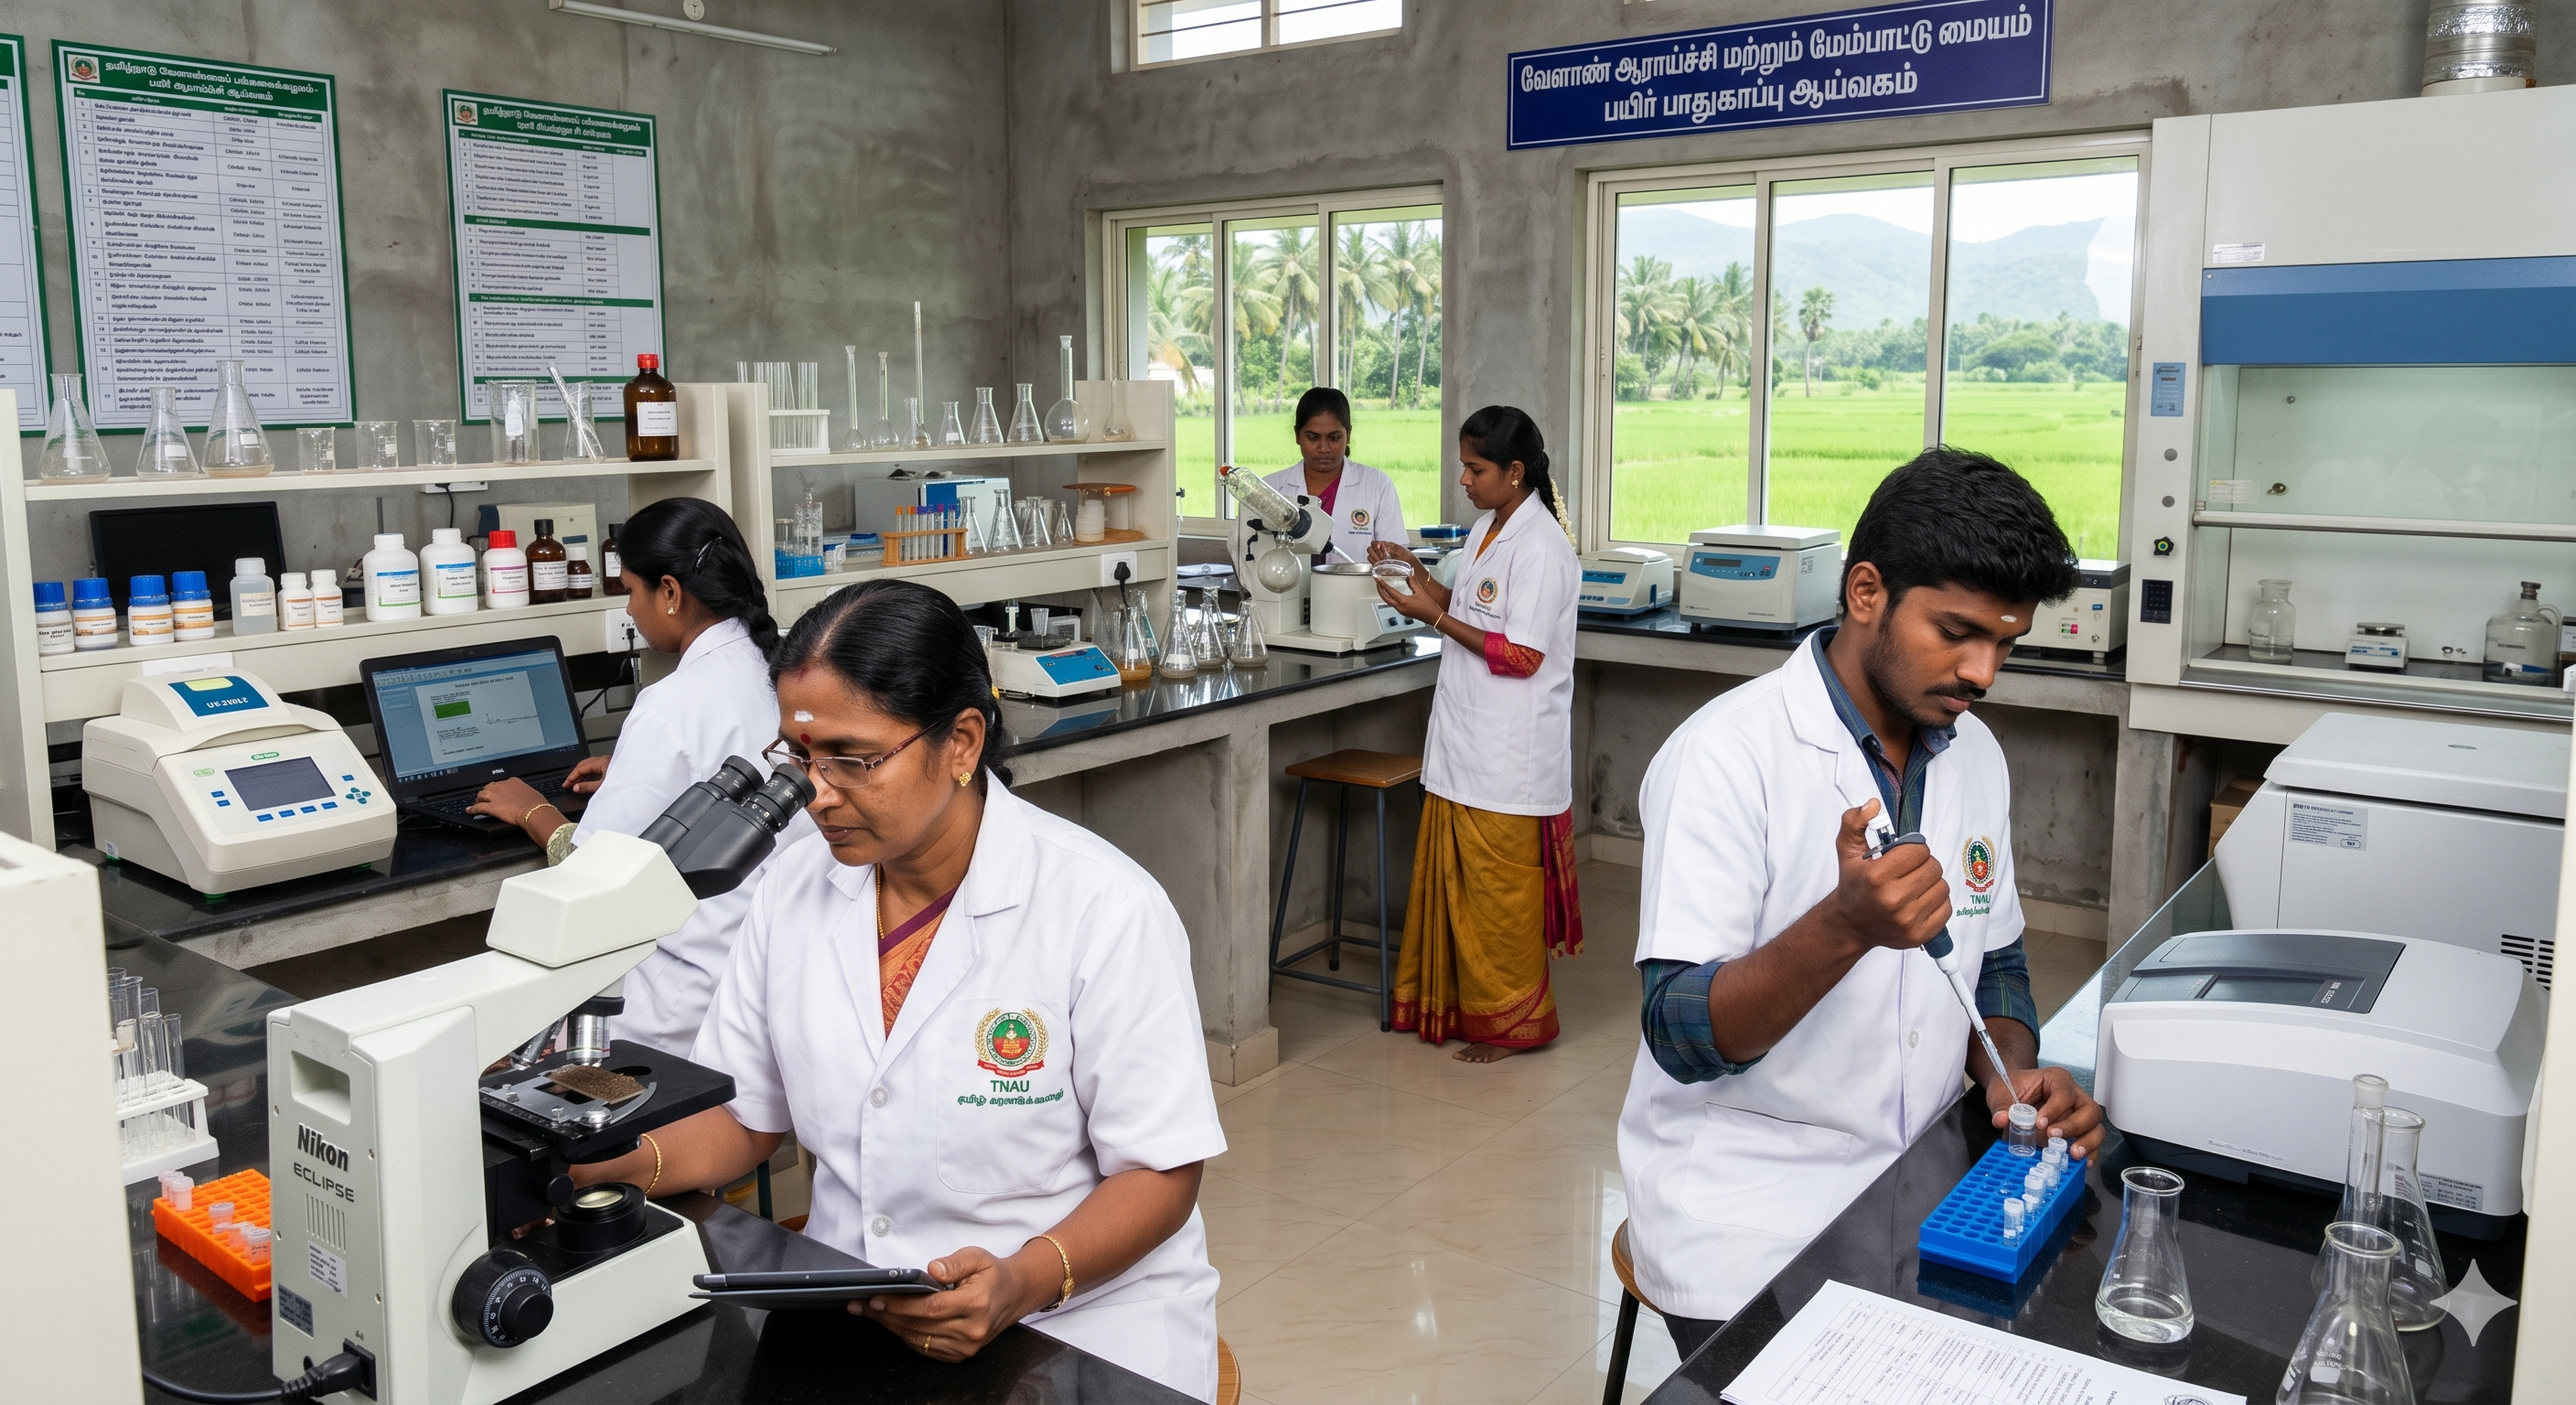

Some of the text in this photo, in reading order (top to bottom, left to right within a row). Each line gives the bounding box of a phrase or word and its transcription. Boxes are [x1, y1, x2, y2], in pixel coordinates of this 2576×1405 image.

[1521, 3, 2033, 92] வேளாண் ஆராய்ச்சி மற்றும் மேம்பாட்டு மையம்
[1605, 61, 1918, 124] பயிர் பாதுகாப்பு ஆய்வகம்
[1970, 895, 1991, 905] TNAU
[990, 1079, 1030, 1093] TNAU
[297, 1122, 349, 1173] Nikon
[293, 1162, 355, 1203] ECLIPSE
